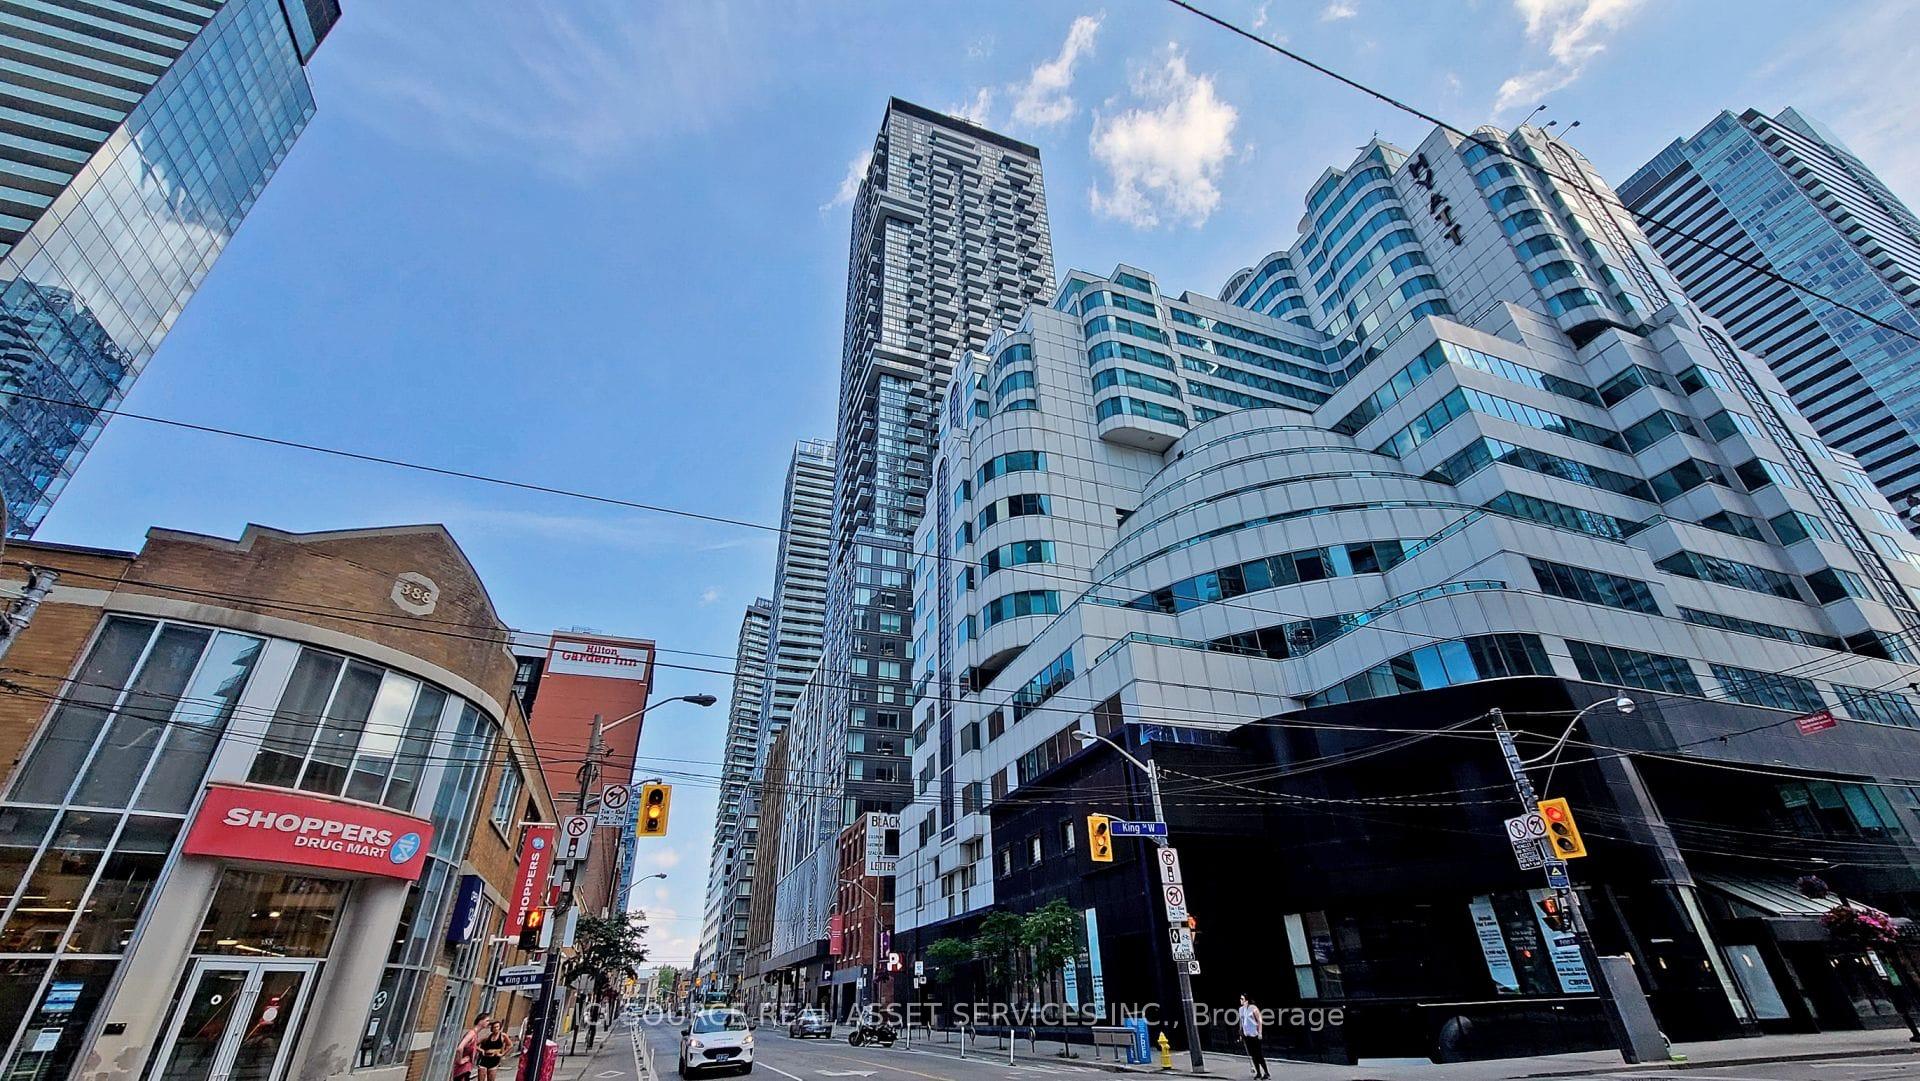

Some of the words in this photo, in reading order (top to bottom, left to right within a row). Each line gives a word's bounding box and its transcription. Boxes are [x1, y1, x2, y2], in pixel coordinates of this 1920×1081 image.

[1408, 152, 1462, 246] HYATT
[585, 644, 618, 656] Hilton
[222, 807, 393, 848] SHOPPERS
[871, 815, 901, 828] BLACK
[1122, 823, 1141, 835] King
[1148, 823, 1155, 832] W
[294, 835, 342, 852] DRUG
[346, 843, 388, 859] MART
[870, 861, 896, 871] LETTER
[516, 852, 540, 927] SHOPPERS
[504, 976, 521, 985] King
[824, 970, 831, 980] P
